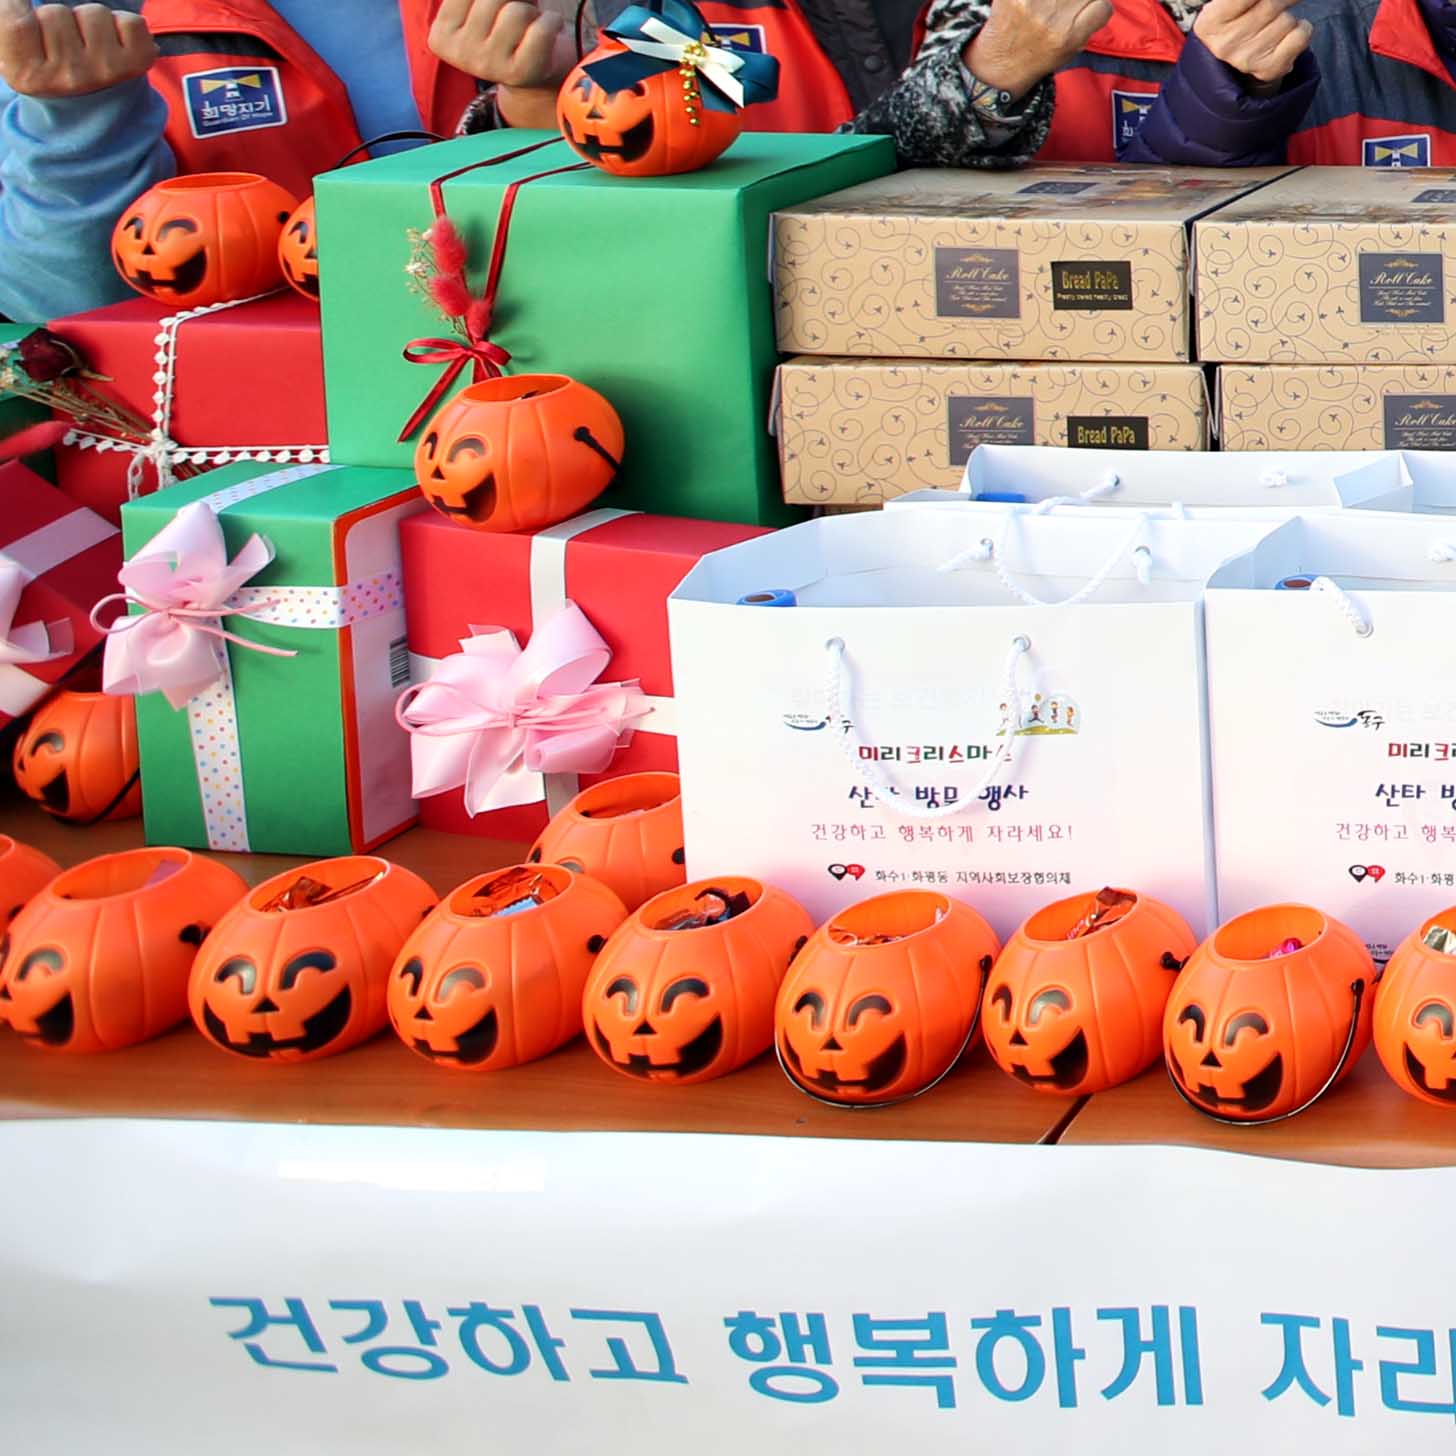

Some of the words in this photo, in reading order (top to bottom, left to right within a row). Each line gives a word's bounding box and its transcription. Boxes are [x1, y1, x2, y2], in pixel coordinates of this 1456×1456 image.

[946, 266, 978, 279] Roll
[980, 267, 1009, 279] Cake
[1370, 271, 1404, 285] Roll
[1405, 273, 1433, 284] Cake
[960, 415, 994, 428] Roll
[995, 416, 1024, 428] Cake
[1395, 412, 1428, 426] Roll
[1077, 426, 1106, 443] Bread
[849, 786, 901, 808] 산
[1375, 784, 1426, 807] 산타
[811, 824, 886, 841] 건강하고
[899, 824, 974, 842] 행복하게
[987, 824, 1073, 842] 자라세요!
[1336, 823, 1409, 841] 건강하고
[956, 871, 1071, 885] 지역사회보장협의체
[207, 1296, 690, 1386] 건강하고
[724, 1303, 1204, 1410] 행복하게
